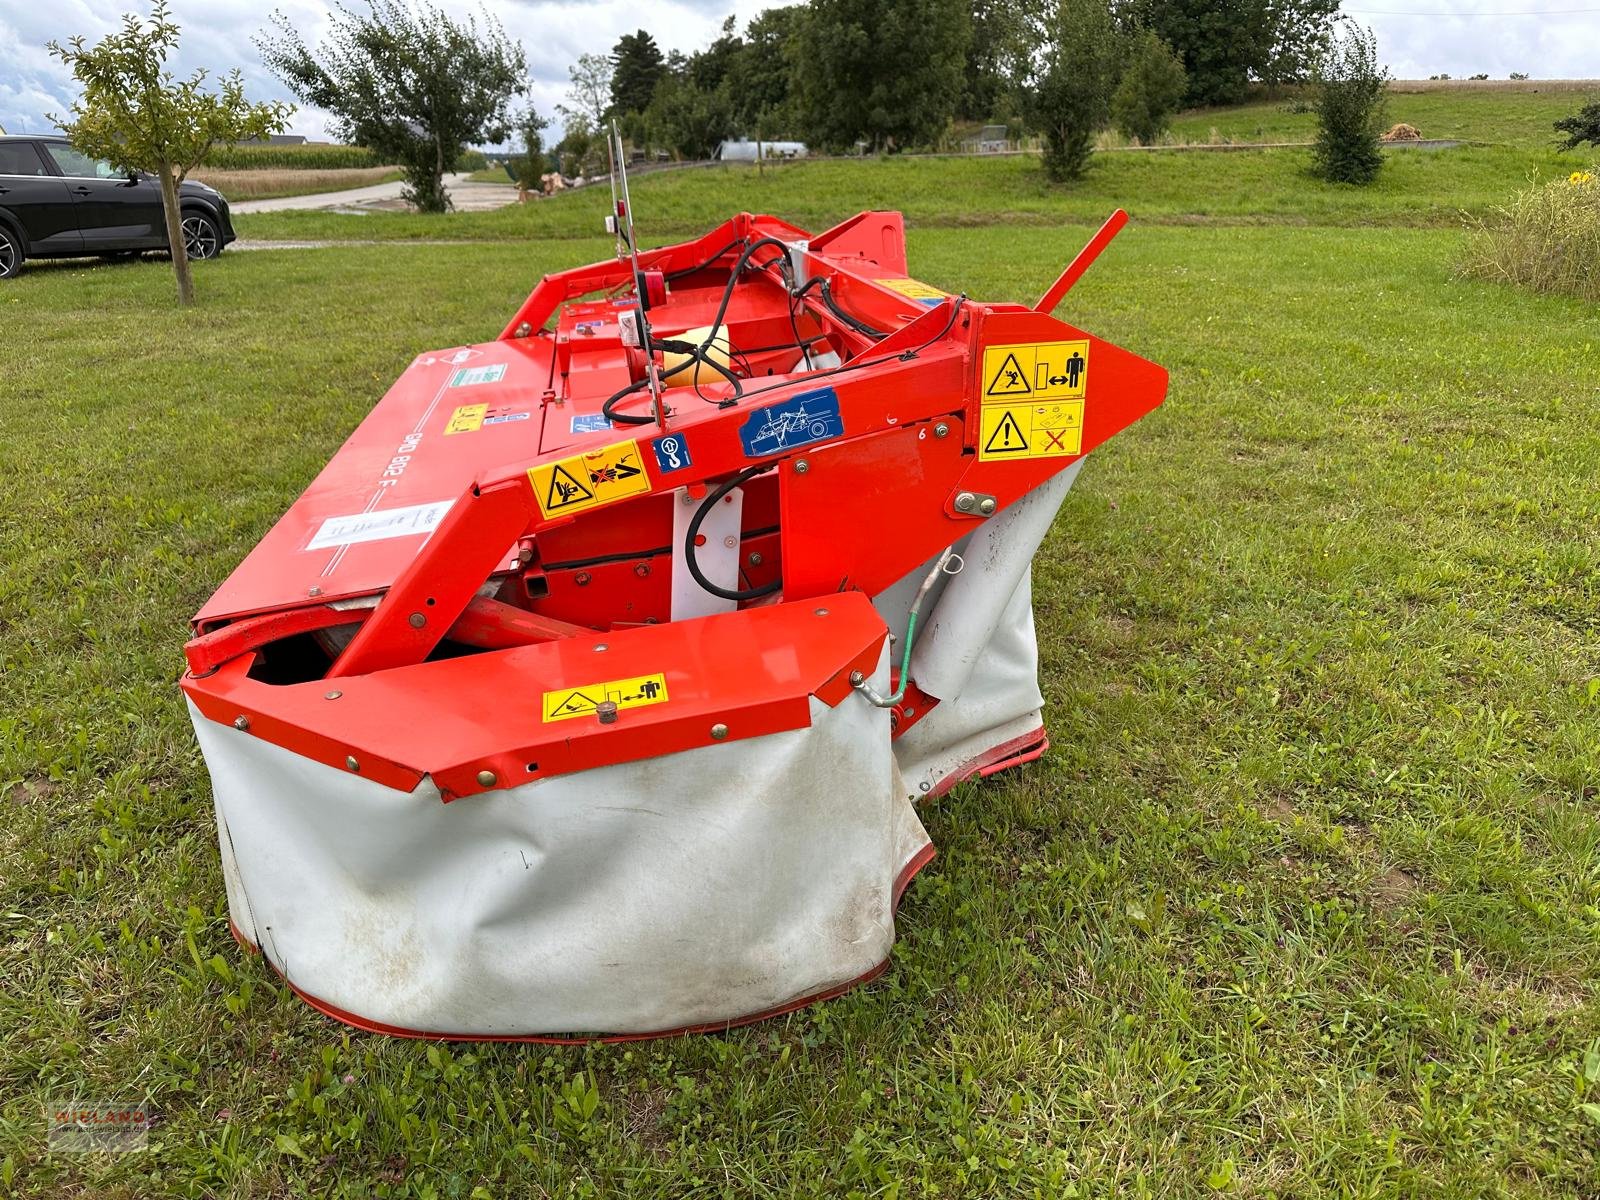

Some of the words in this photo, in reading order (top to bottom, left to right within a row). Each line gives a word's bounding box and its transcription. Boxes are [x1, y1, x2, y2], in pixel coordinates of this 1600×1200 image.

[918, 427, 927, 440] 6
[382, 455, 411, 477] 802
[378, 479, 398, 487] F
